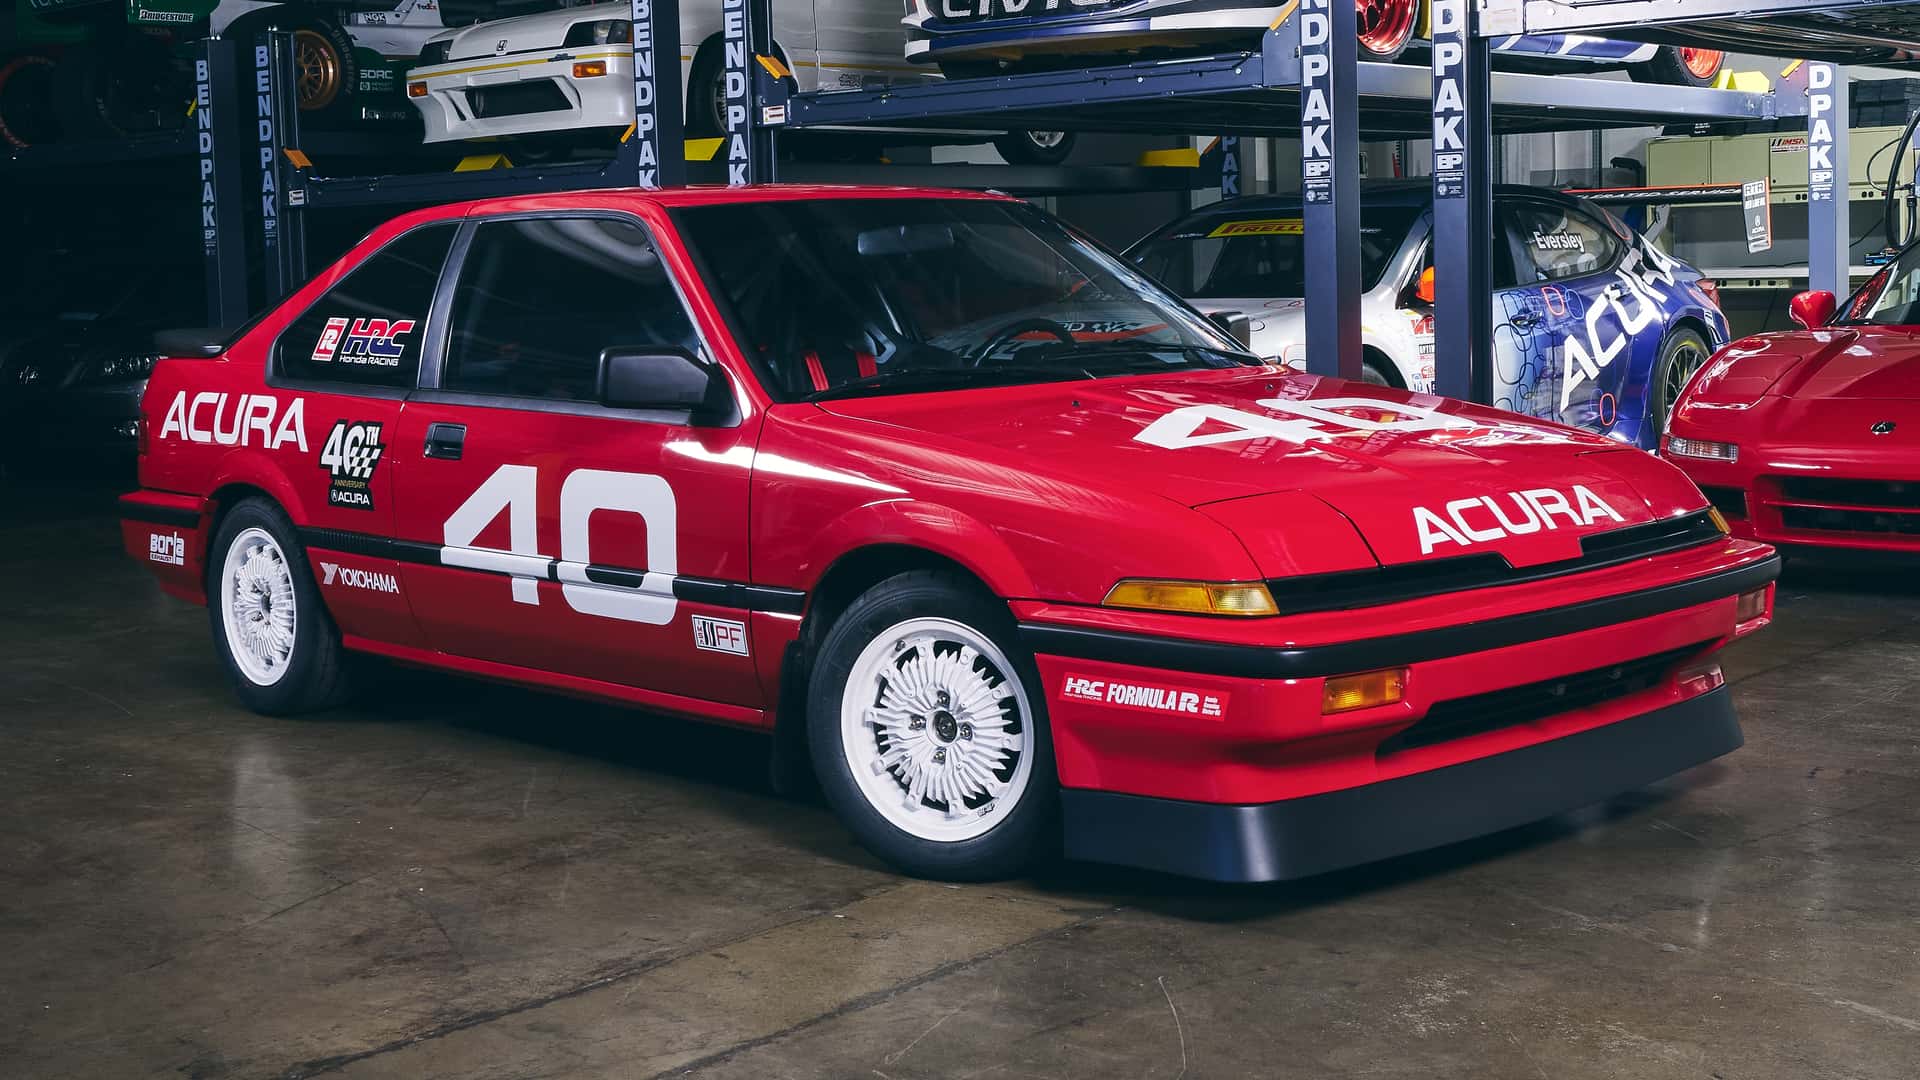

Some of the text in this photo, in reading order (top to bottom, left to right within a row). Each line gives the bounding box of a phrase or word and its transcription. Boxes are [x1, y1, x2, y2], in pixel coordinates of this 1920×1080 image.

[141, 10, 193, 21] BRIDGESTONE
[364, 12, 386, 21] NGK
[195, 59, 216, 227] BENDPAK
[255, 45, 276, 217] BENDPAK
[1221, 221, 1304, 234] PIRELL
[1533, 231, 1585, 253] Eversley
[341, 318, 416, 357] HRC
[1560, 233, 1681, 414] ACURA
[339, 355, 367, 364] Honda
[367, 356, 399, 367] RACING
[160, 390, 309, 453] ACURA
[337, 491, 371, 505] ACURA
[1411, 485, 1625, 555] ACURA
[440, 463, 678, 626] 40
[338, 567, 400, 594] YOKOHAMA
[715, 625, 741, 648] PF
[1065, 677, 1105, 697] HRC
[1106, 683, 1177, 711] FORMULA
[1178, 692, 1200, 713] R
